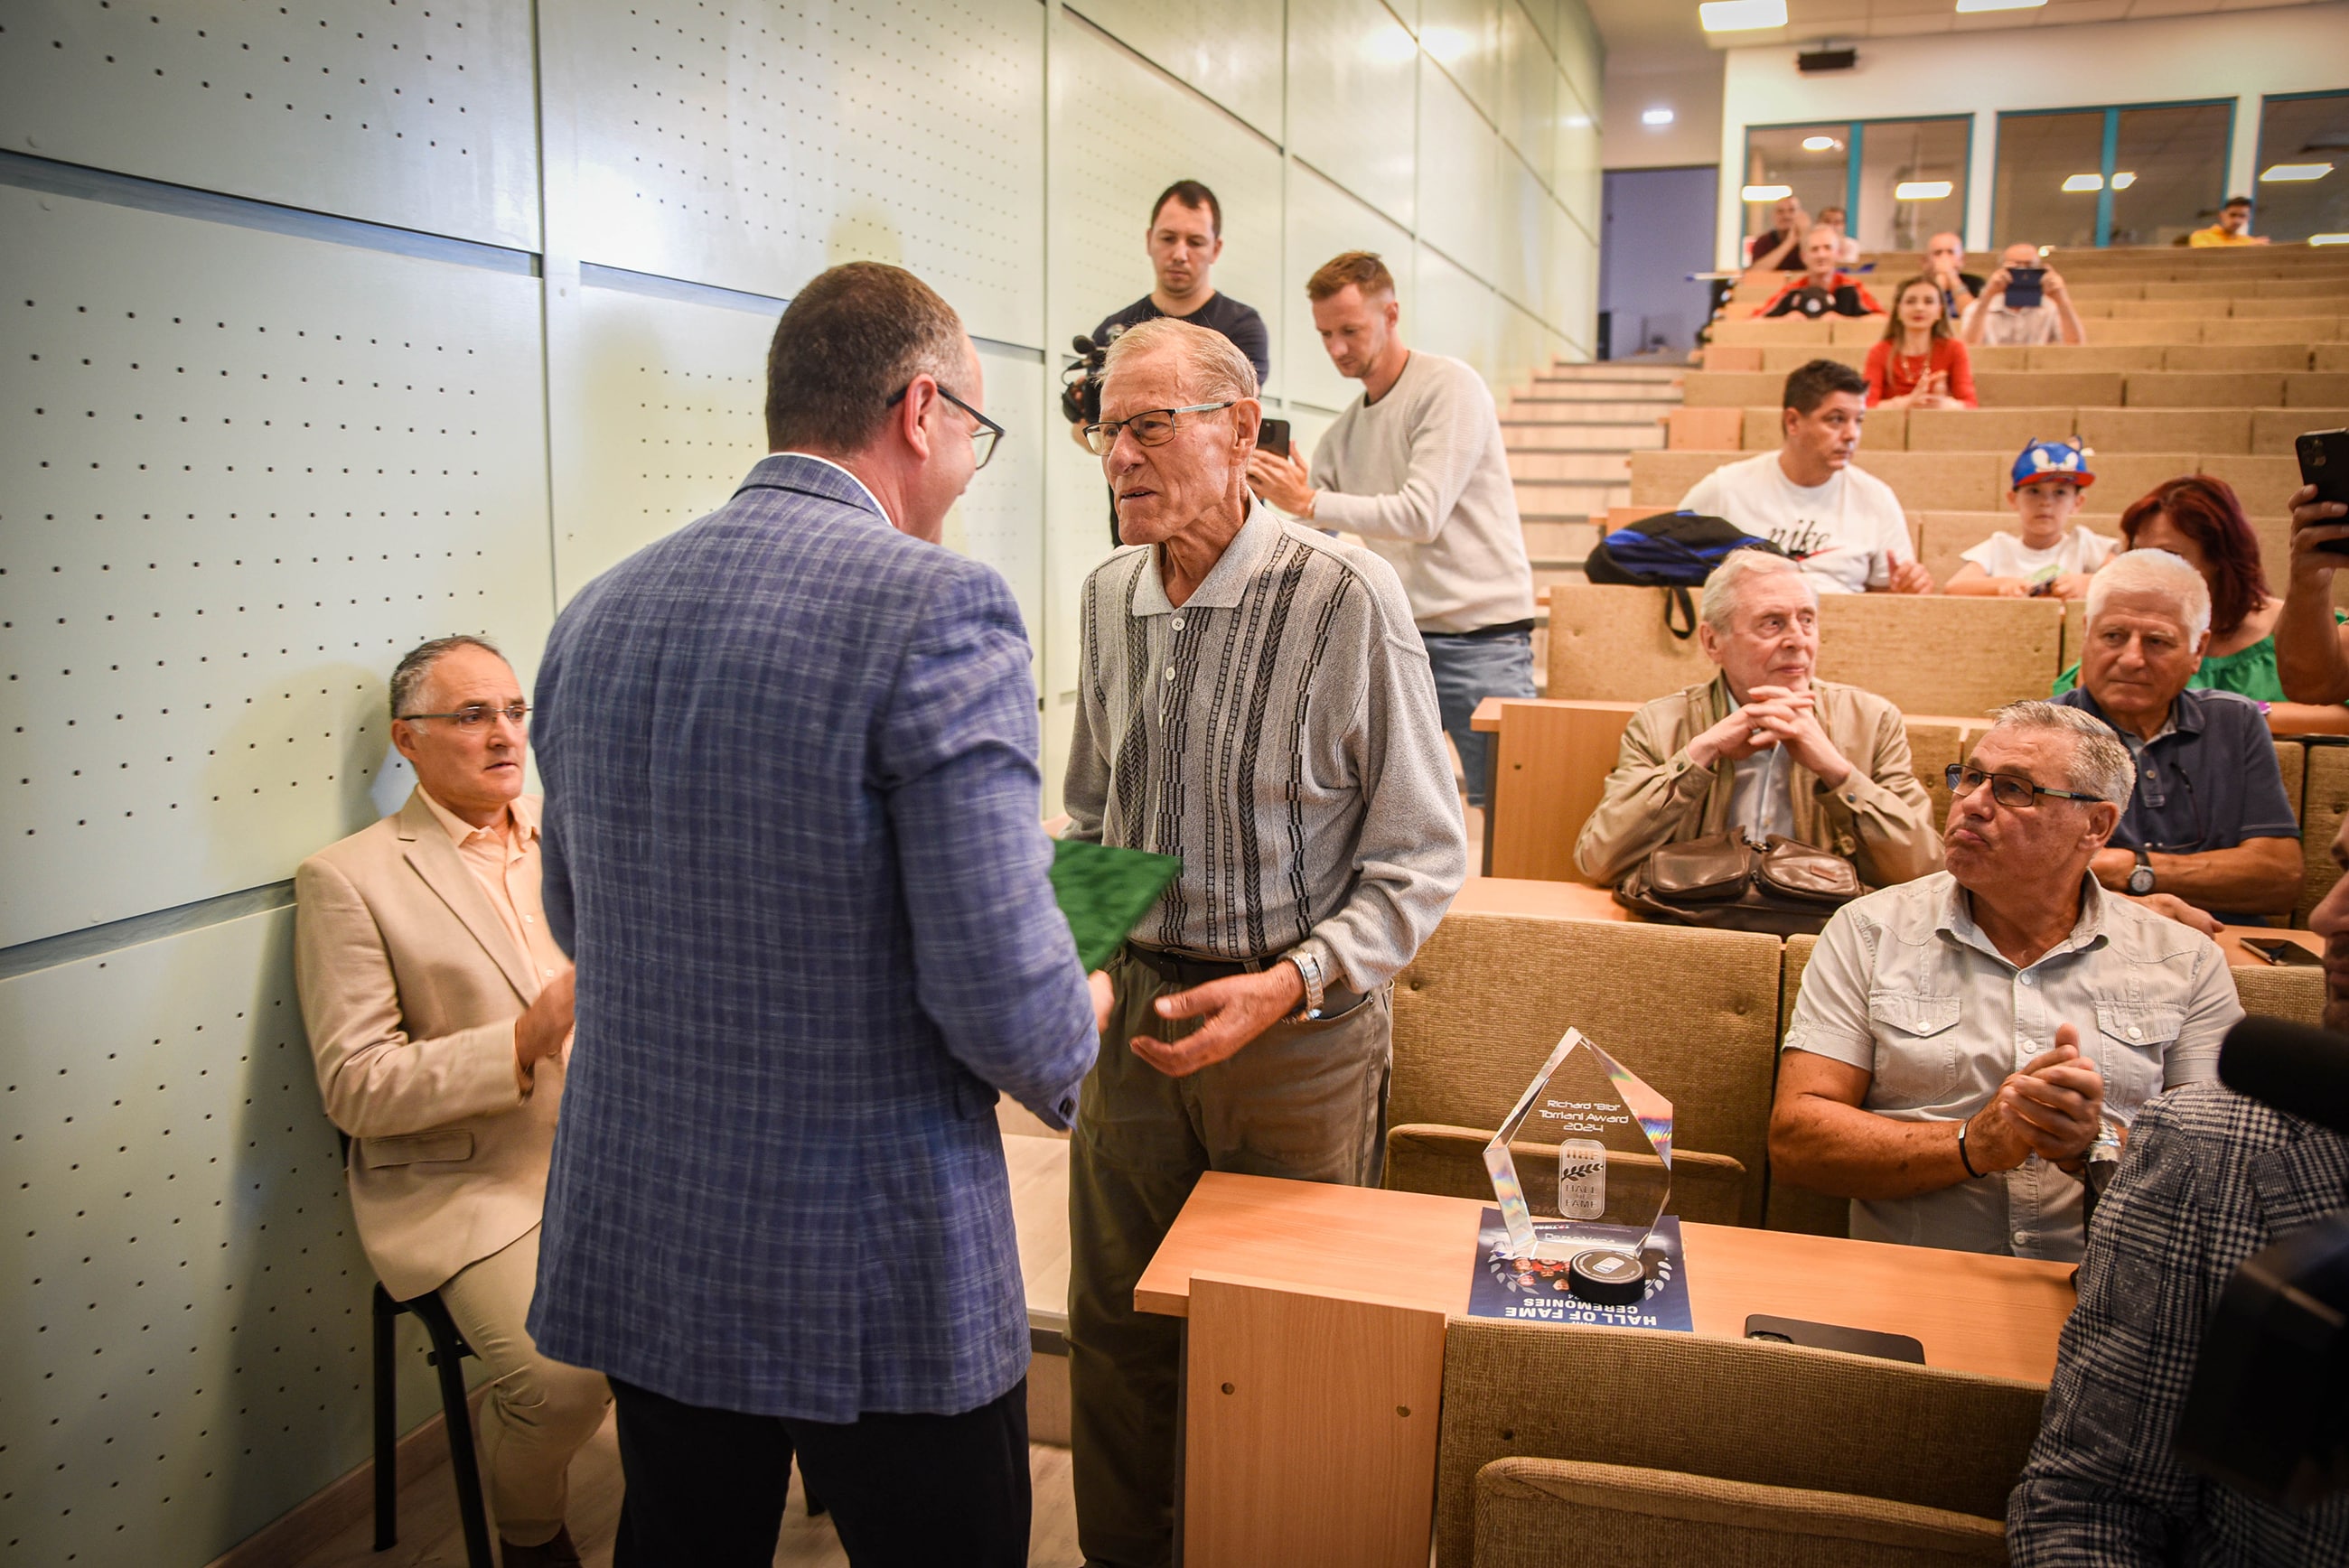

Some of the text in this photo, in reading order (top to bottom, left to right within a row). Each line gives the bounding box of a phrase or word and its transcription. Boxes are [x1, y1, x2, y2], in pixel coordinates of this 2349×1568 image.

[1547, 1099, 1592, 1110] Richard
[1539, 1109, 1630, 1125] Torriani Award
[1563, 1122, 1605, 1133] 2024
[1565, 1184, 1598, 1196] HALL
[1565, 1199, 1598, 1209] FAME
[1523, 1298, 1639, 1314] CEREMONIES
[1504, 1306, 1564, 1319] FAME
[1568, 1311, 1596, 1322] OF
[1600, 1312, 1657, 1326] HALL
